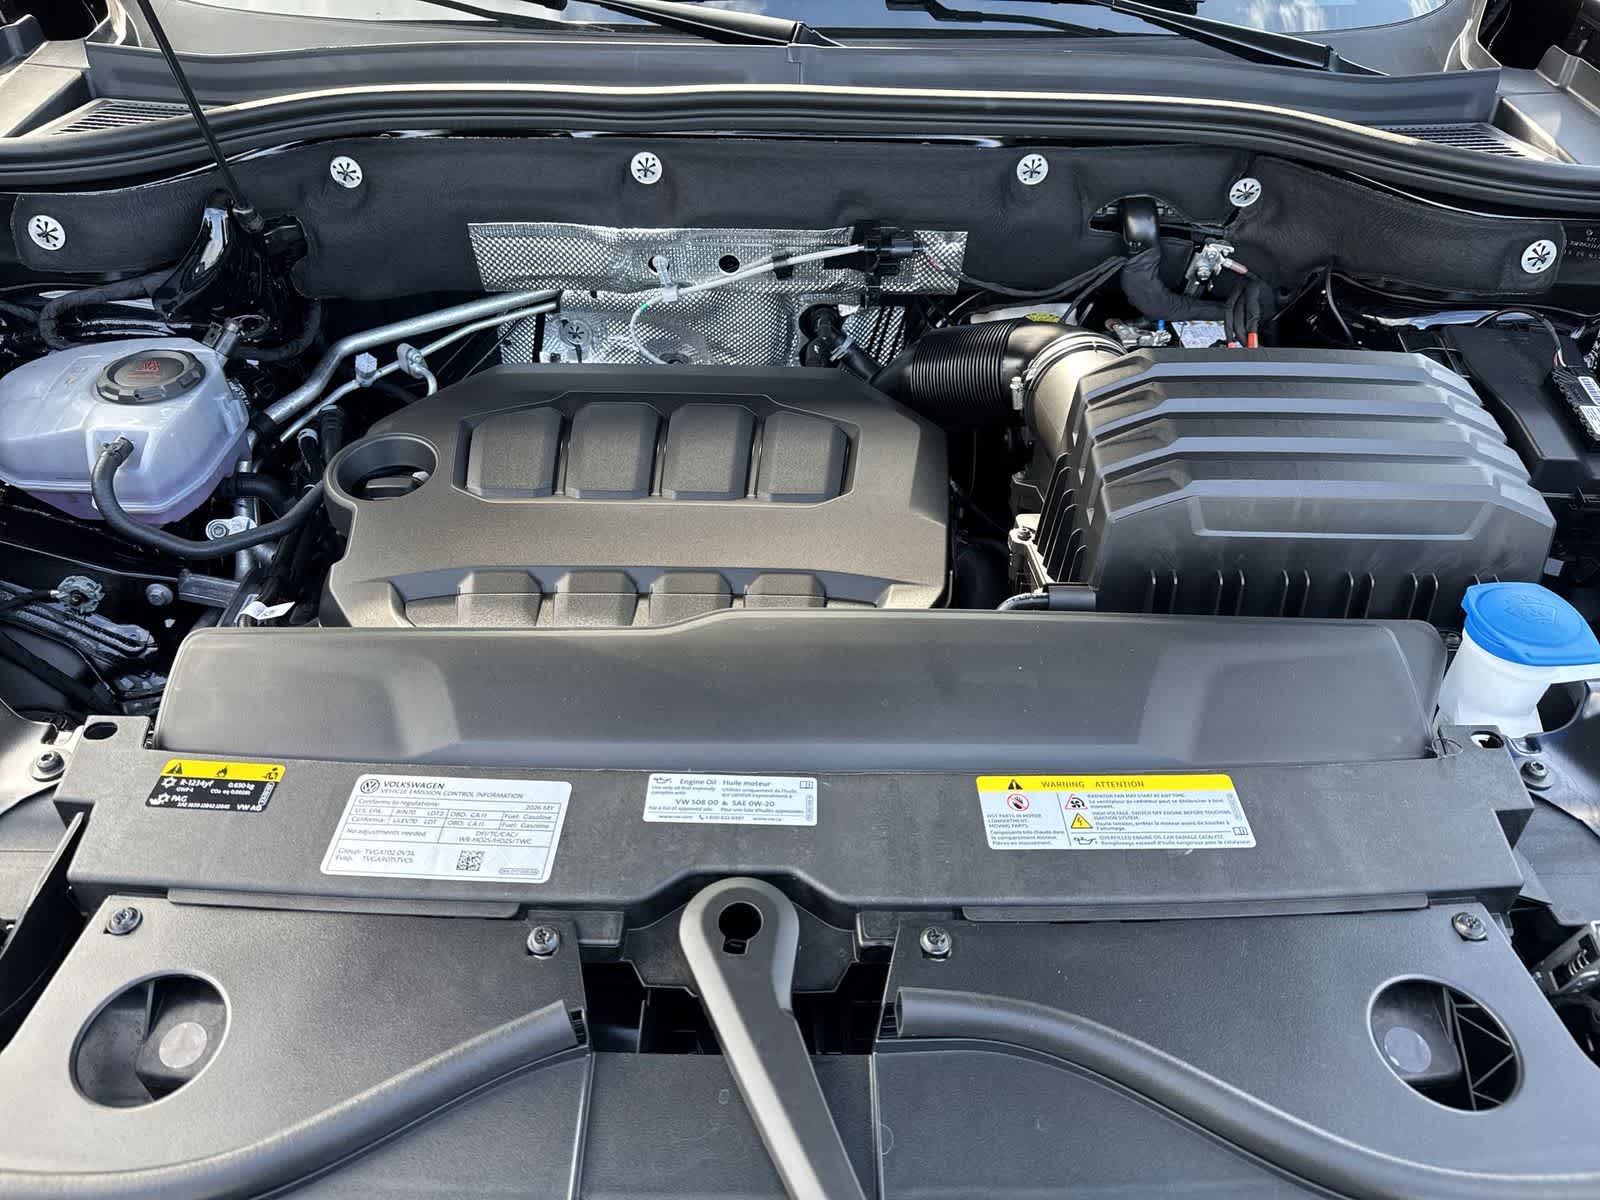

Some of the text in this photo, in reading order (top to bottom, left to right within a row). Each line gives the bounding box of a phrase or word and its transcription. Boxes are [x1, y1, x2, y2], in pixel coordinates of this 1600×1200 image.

[383, 781, 446, 790] VOLKSWAGEN
[680, 778, 705, 786] Engine
[1095, 780, 1145, 788] ATTENTION
[475, 791, 524, 799] INFORMATION
